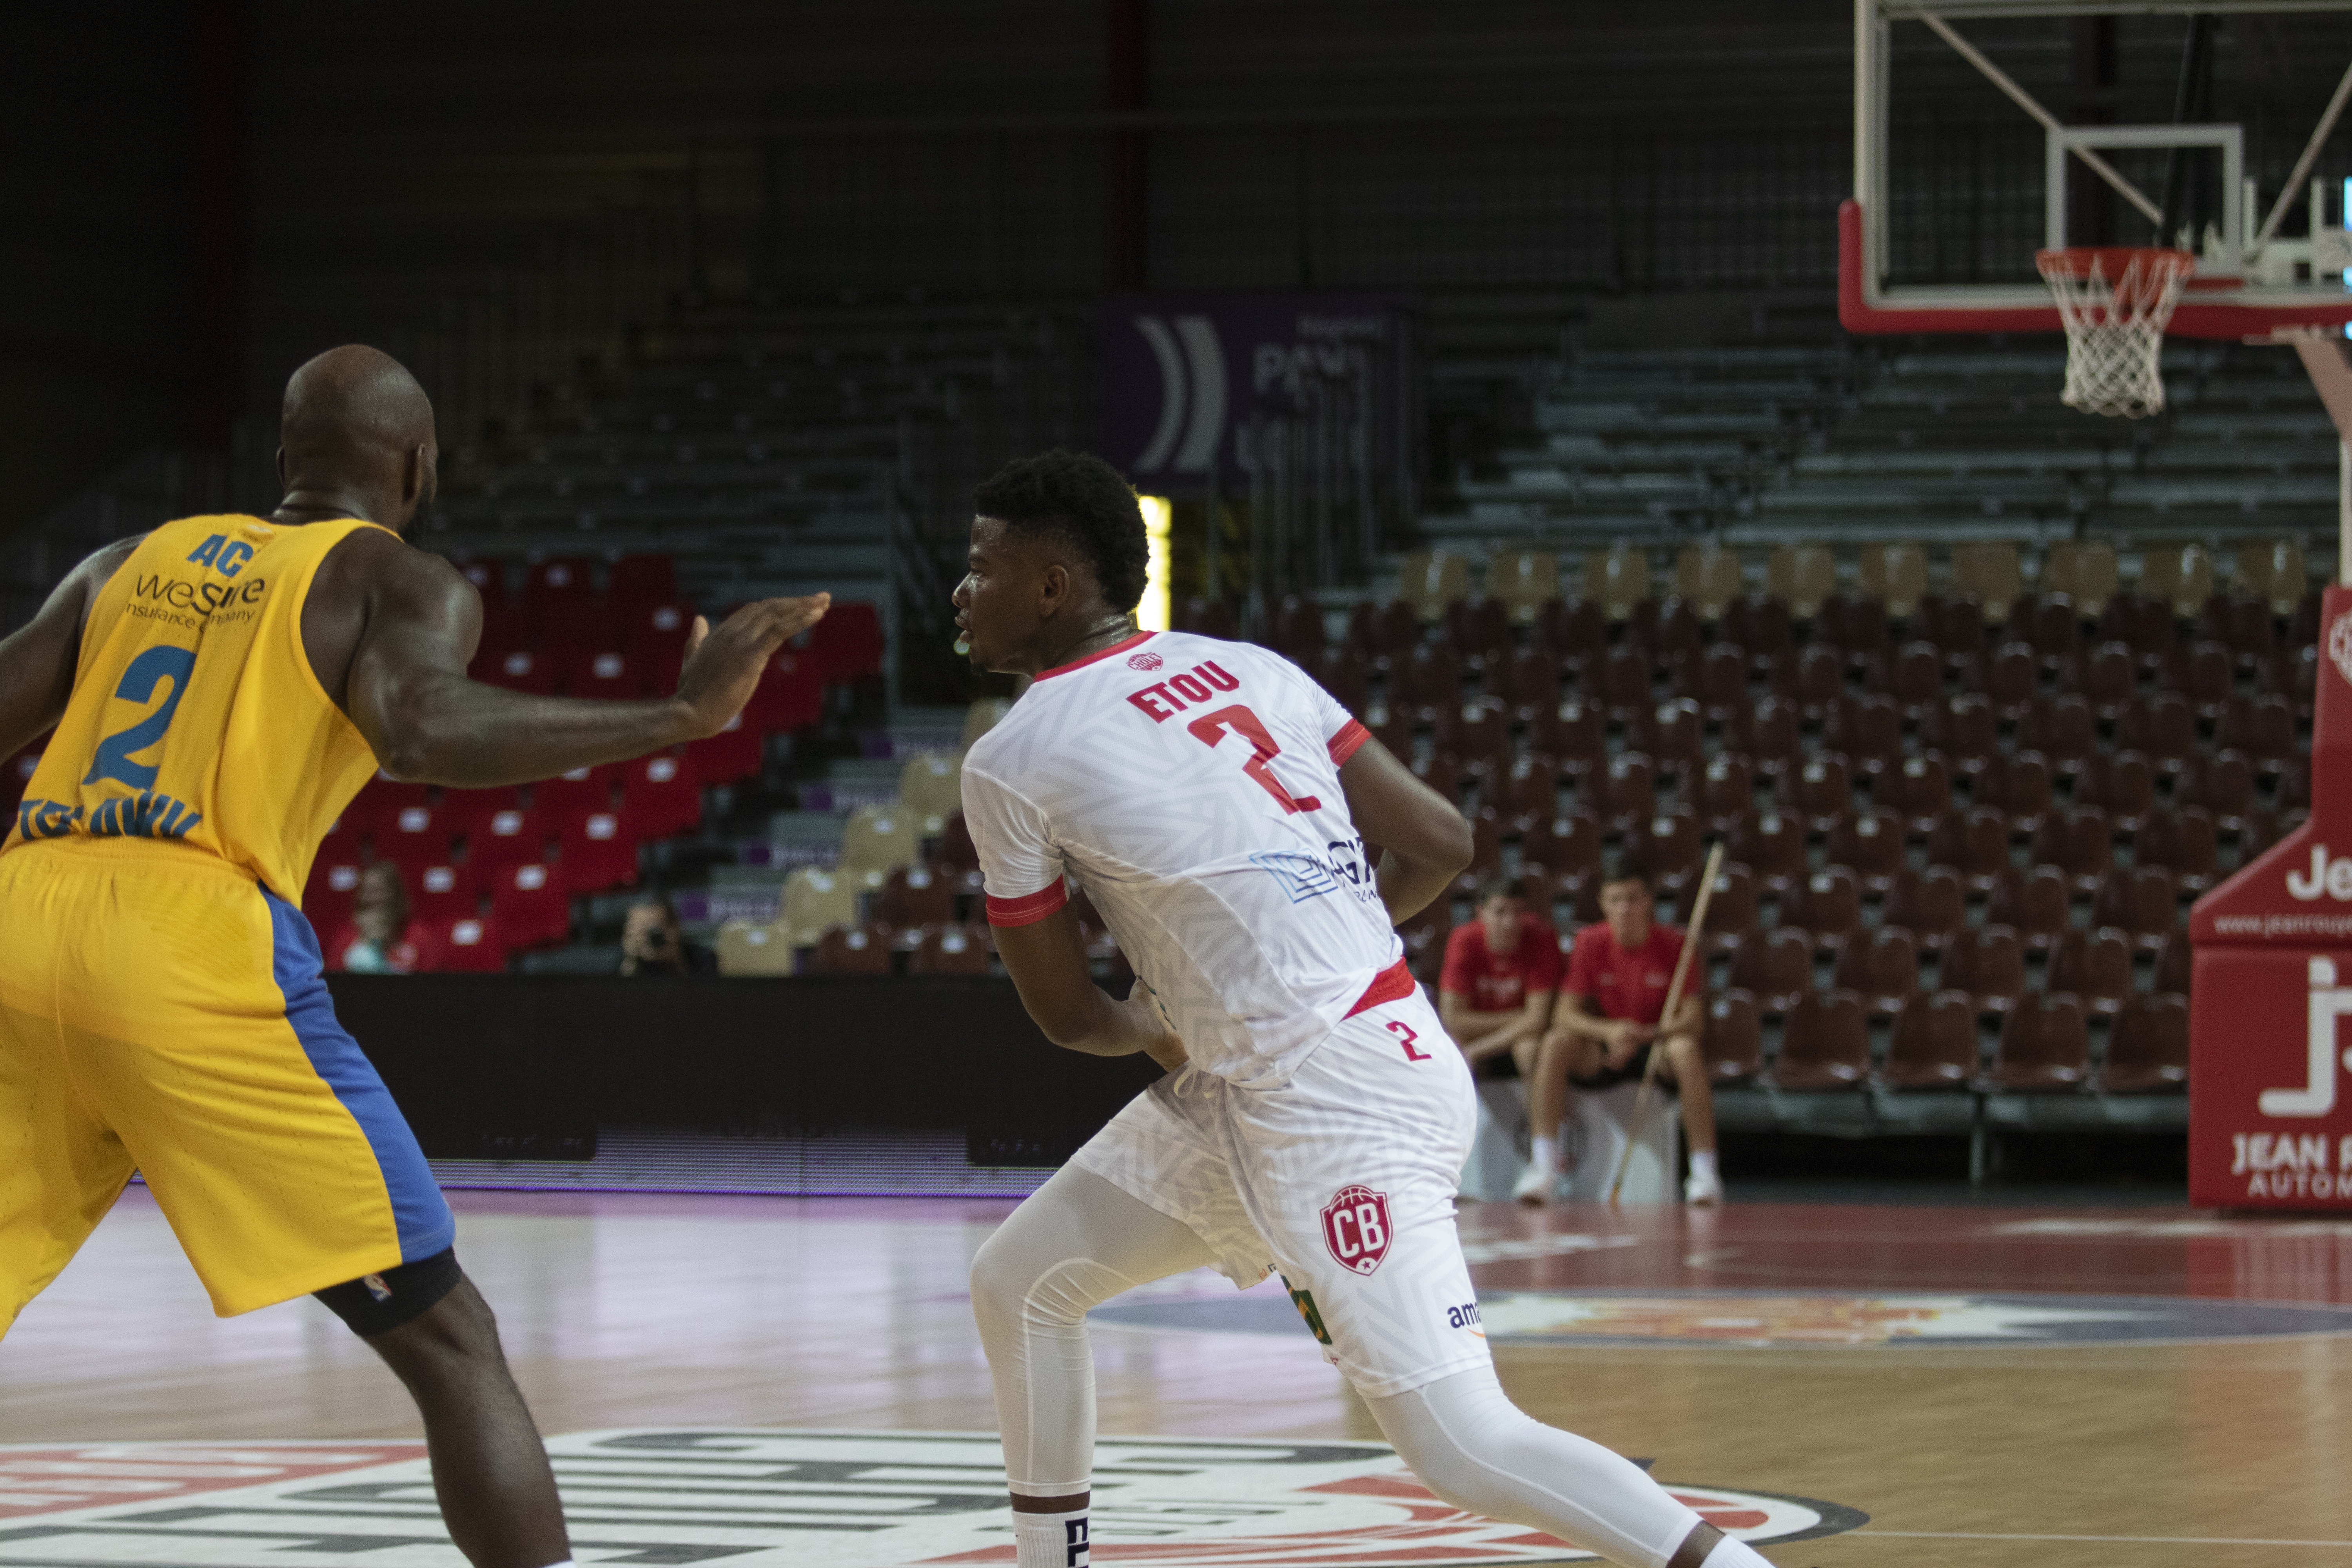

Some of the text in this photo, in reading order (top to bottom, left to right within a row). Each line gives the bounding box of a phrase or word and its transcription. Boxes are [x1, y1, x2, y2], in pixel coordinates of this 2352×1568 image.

[1127, 652, 1162, 670] CHOLET
[82, 645, 197, 790] 2
[1125, 660, 1240, 724] ETOU
[1187, 704, 1322, 816] 2
[1386, 1020, 1432, 1062] 2
[2230, 1132, 2329, 1175] JEAN
[1333, 1202, 1384, 1260] CB
